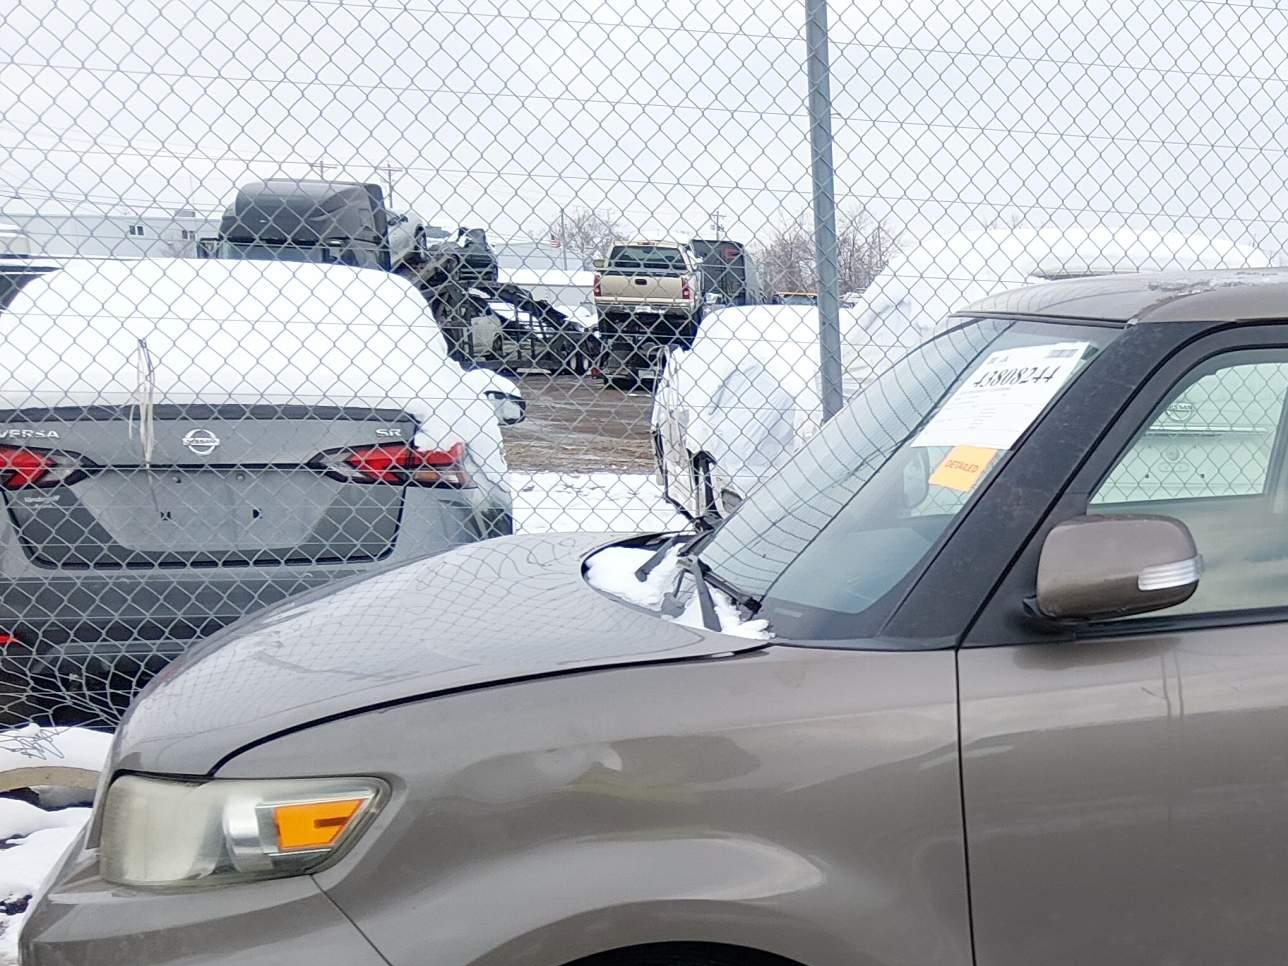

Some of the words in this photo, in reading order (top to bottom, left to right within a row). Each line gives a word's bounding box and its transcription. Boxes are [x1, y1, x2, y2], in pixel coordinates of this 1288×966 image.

[974, 366, 1061, 388] 43808244
[0, 429, 60, 439] VERSA
[375, 428, 402, 437] SR
